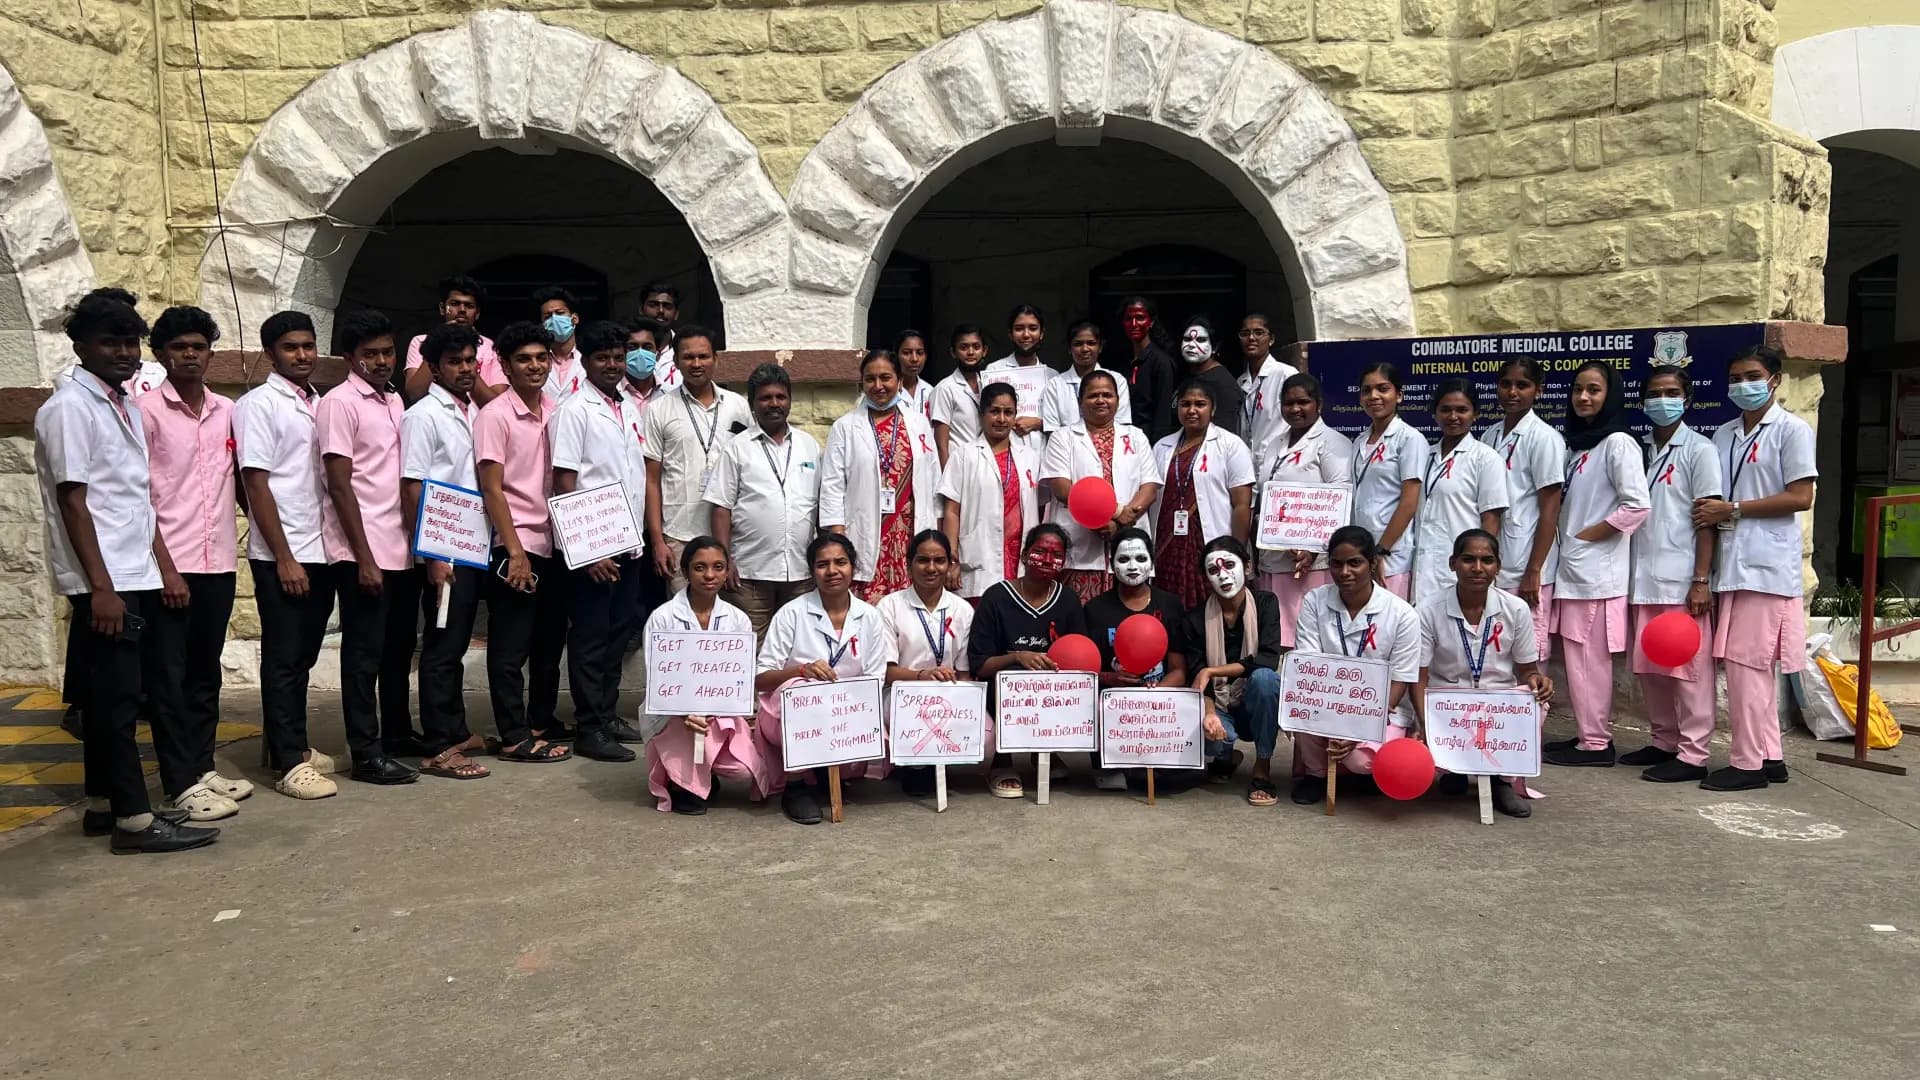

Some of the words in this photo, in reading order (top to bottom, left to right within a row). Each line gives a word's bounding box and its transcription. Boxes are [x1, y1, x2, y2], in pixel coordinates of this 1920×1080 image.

[1412, 339, 1498, 356] COIMBATORE
[1502, 337, 1565, 353] MEDICAL
[1569, 334, 1633, 351] COLLEGE
[1412, 362, 1468, 375] INTERNAL
[696, 639, 748, 653] TESTED,
[658, 661, 687, 673] GET
[690, 661, 745, 674] TREATED,
[658, 683, 689, 698] GET
[832, 692, 849, 704] THE
[832, 702, 873, 717] SILENCE,
[915, 708, 977, 721] AWARENESS,
[793, 728, 823, 741] BREAK
[831, 722, 849, 734] THE
[900, 729, 923, 740] NOT
[933, 729, 953, 740] THE
